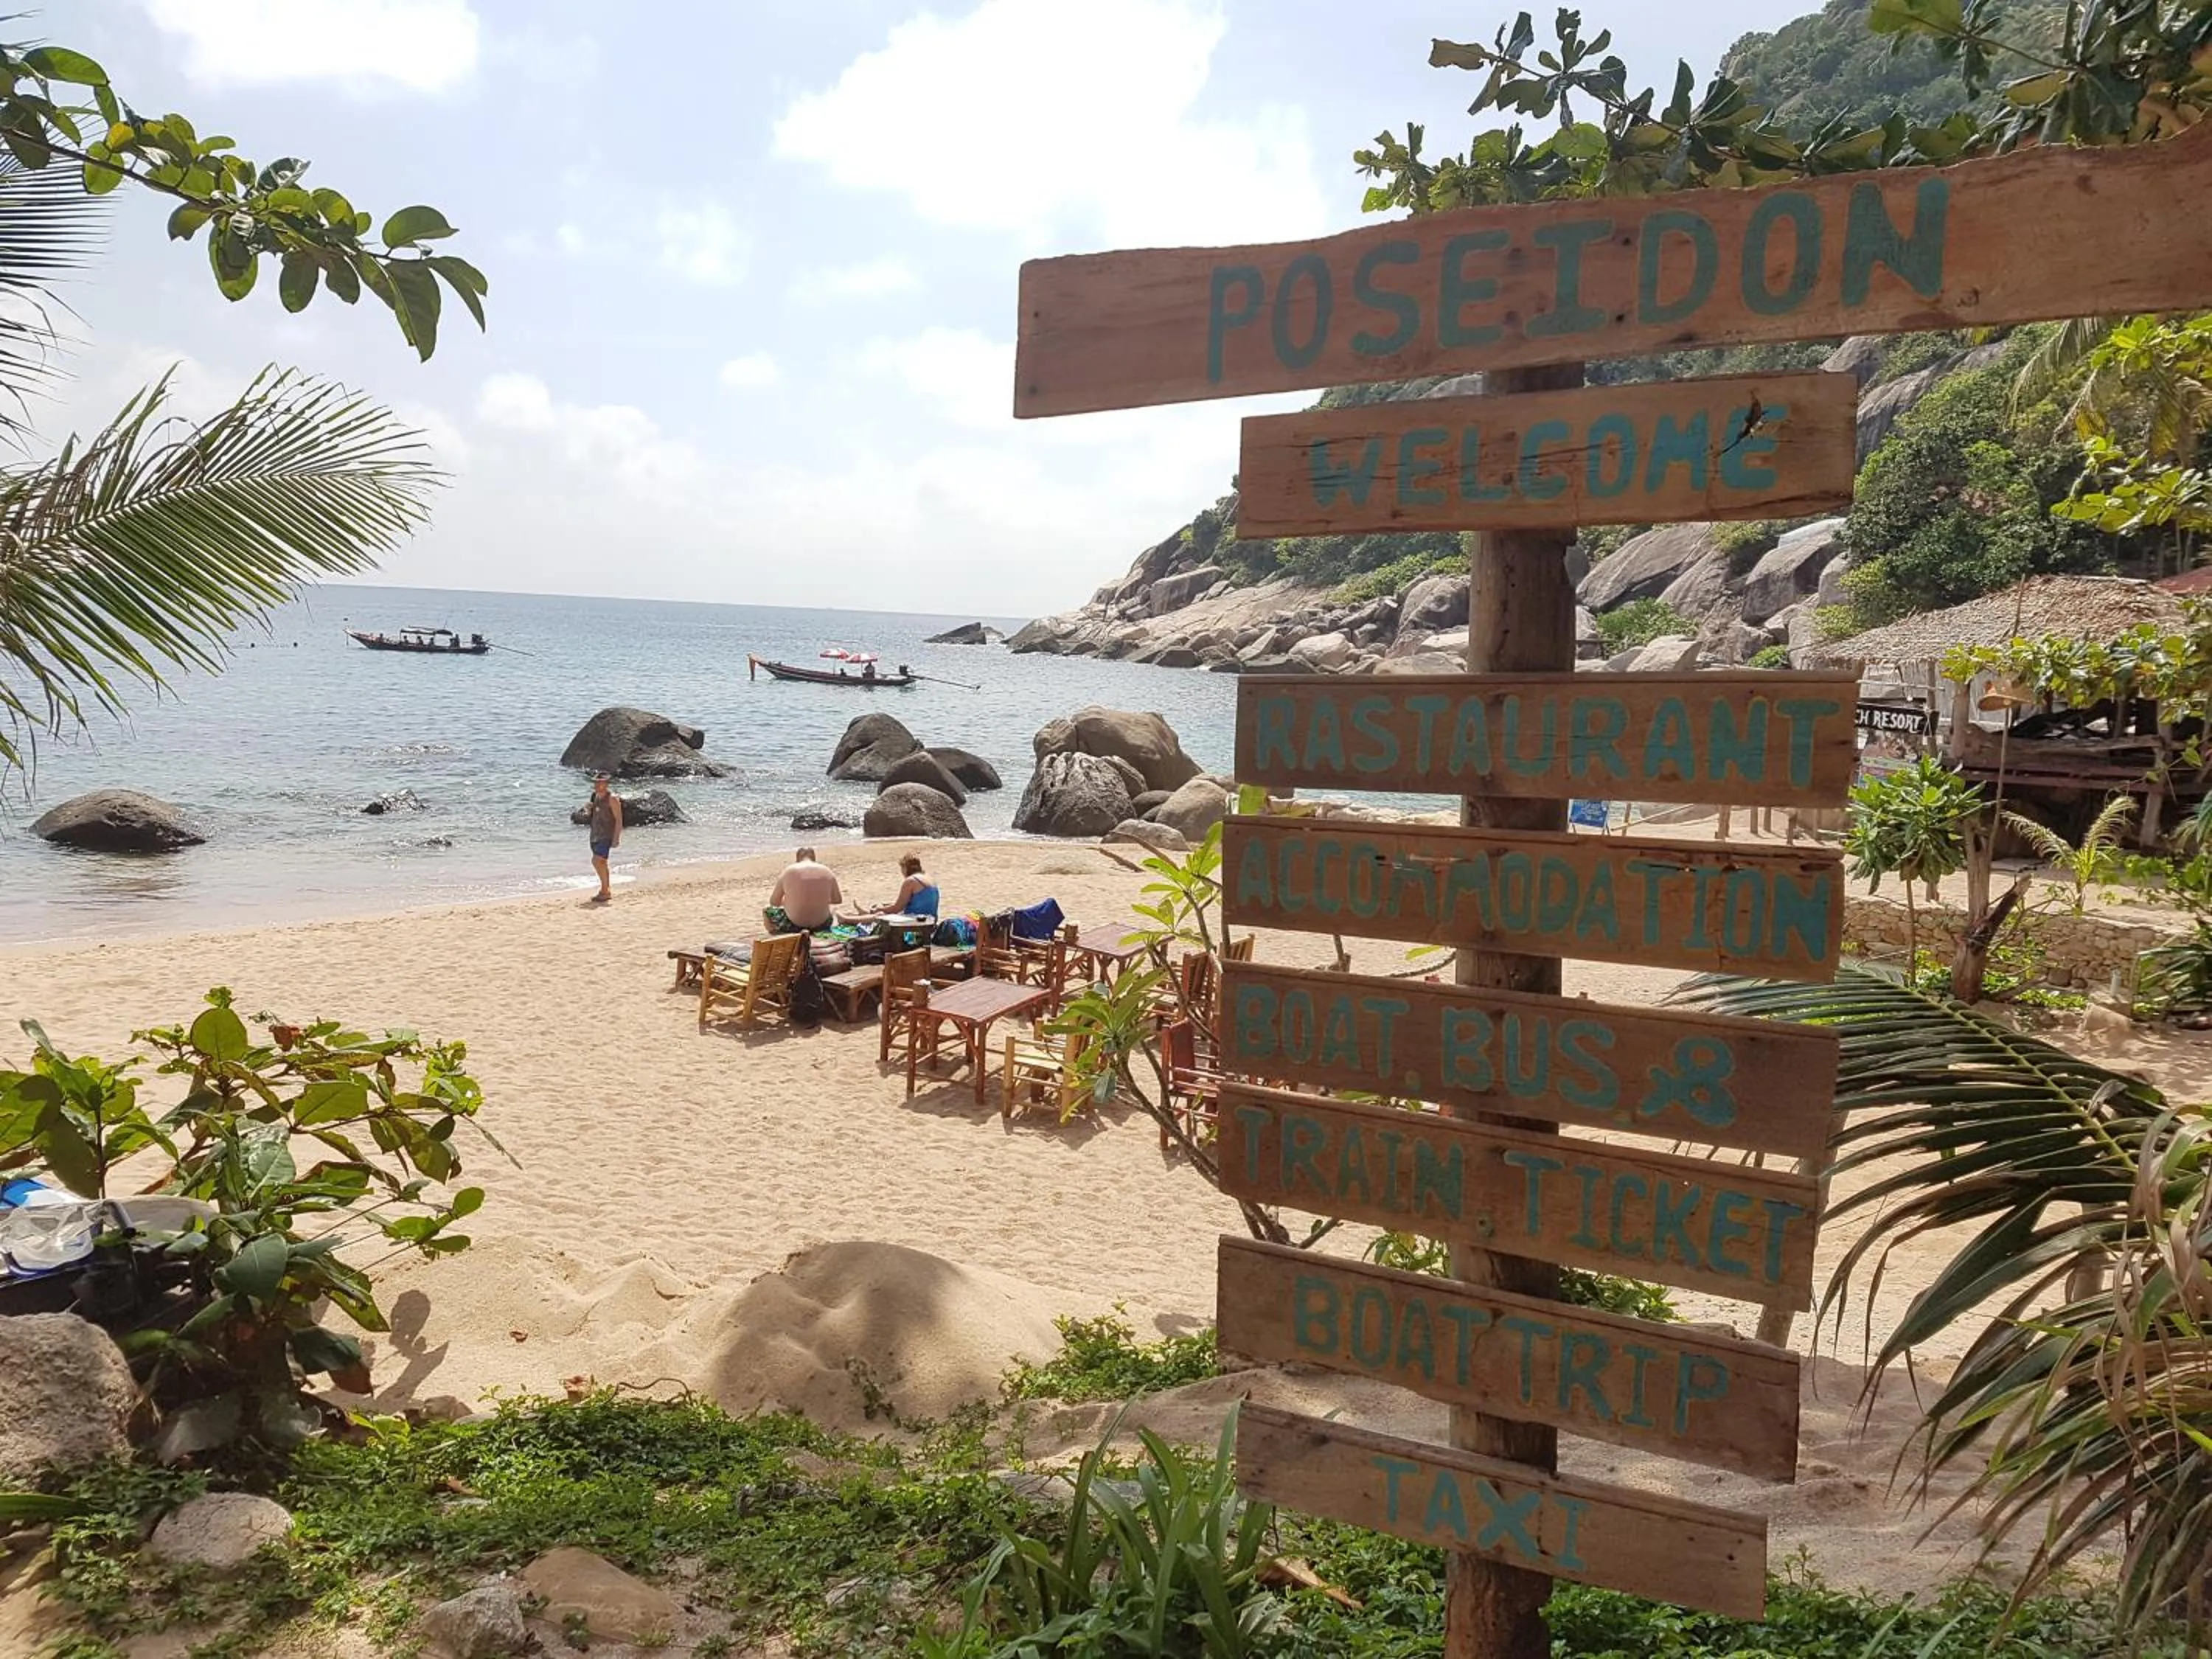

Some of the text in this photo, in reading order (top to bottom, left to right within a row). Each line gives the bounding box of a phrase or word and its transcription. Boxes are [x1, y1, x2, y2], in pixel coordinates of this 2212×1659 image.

[1206, 177, 1950, 384] POSEIDON
[1310, 405, 1789, 507] WELCOME
[1256, 695, 1840, 788] RASTAURANT
[1873, 710, 1923, 734] RESORT
[1238, 837, 1829, 963] ACCOMMODATION
[1638, 1036, 1737, 1128] &
[1503, 1150, 1806, 1284] TICKET
[1293, 1275, 1728, 1434] BOAT TRIP
[1371, 1455, 1593, 1571] TAXI
